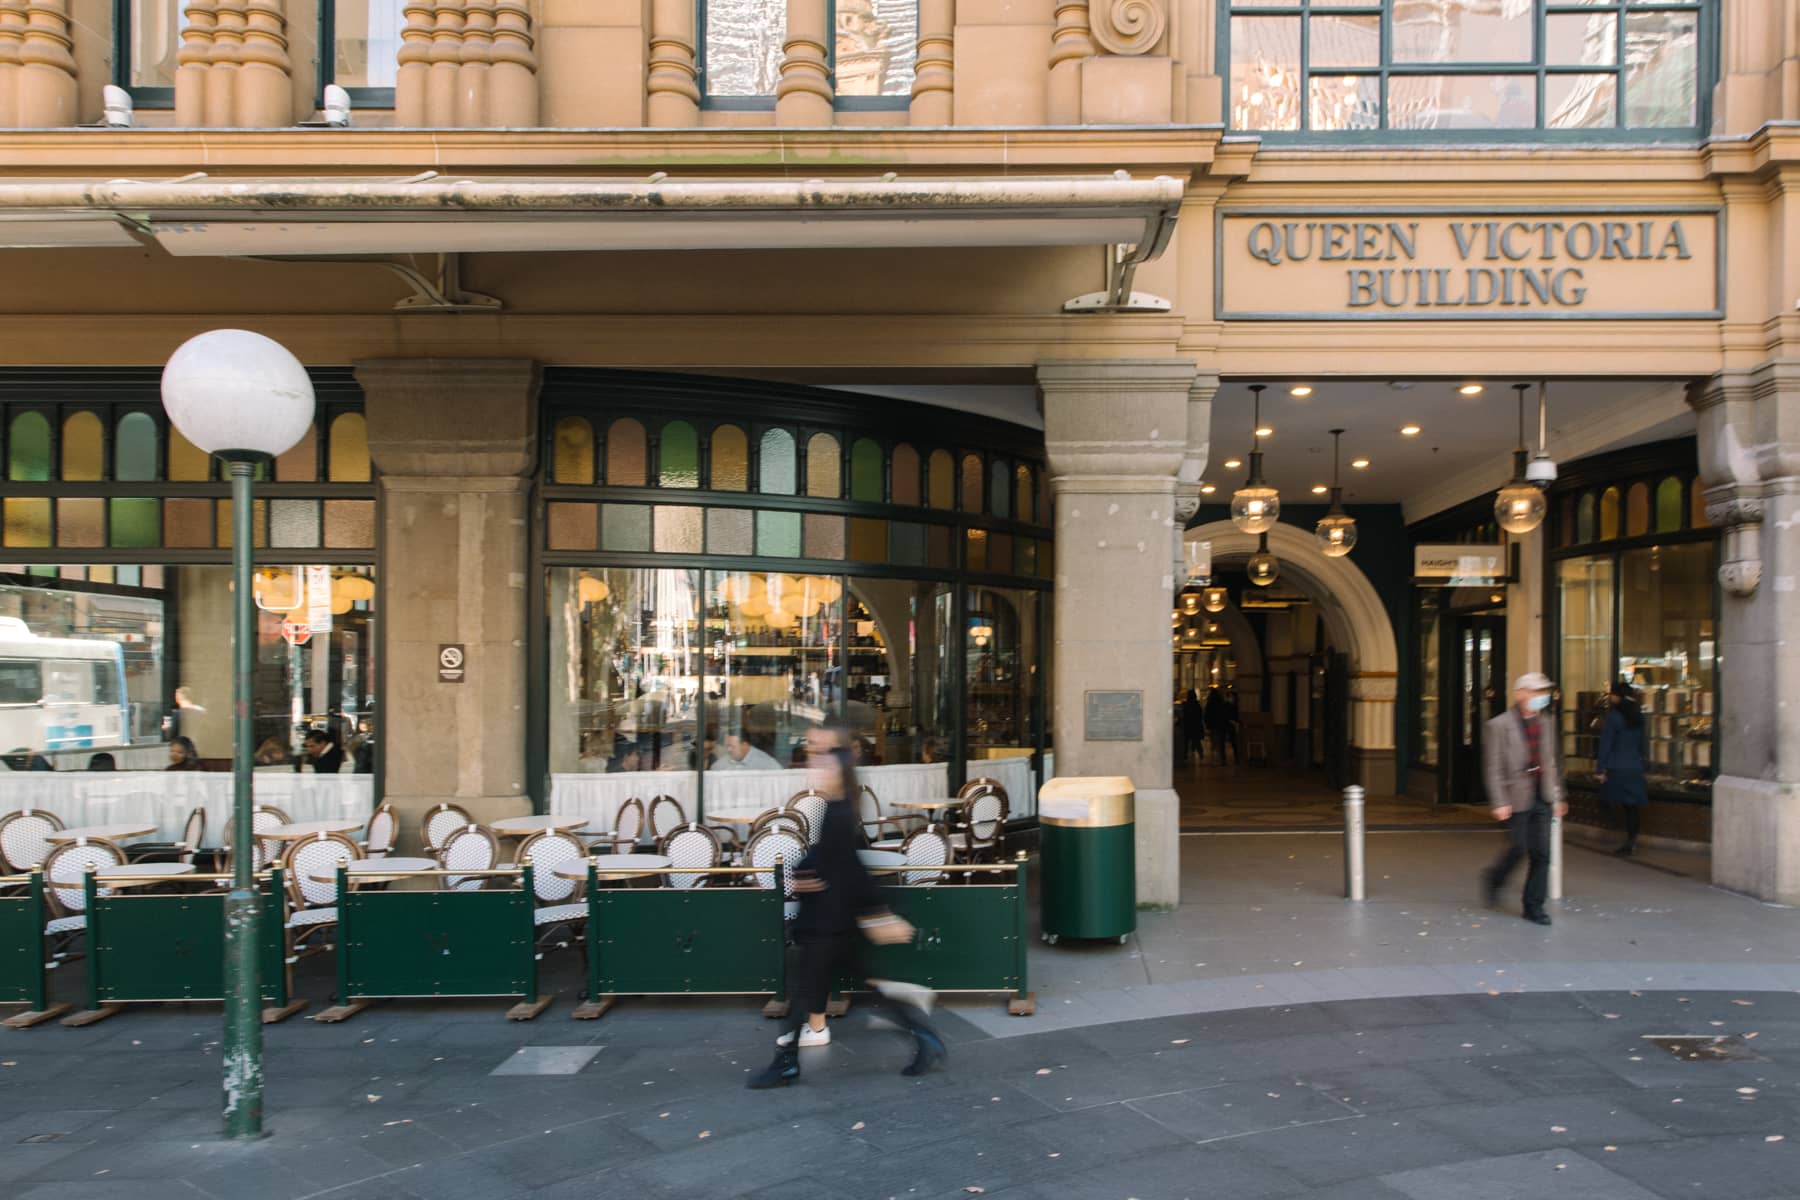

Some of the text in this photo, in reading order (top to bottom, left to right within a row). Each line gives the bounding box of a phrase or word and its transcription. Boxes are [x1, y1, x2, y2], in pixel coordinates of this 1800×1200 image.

[1247, 220, 1692, 265] QUEEN VICTORIA
[1346, 268, 1587, 307] BUILDING
